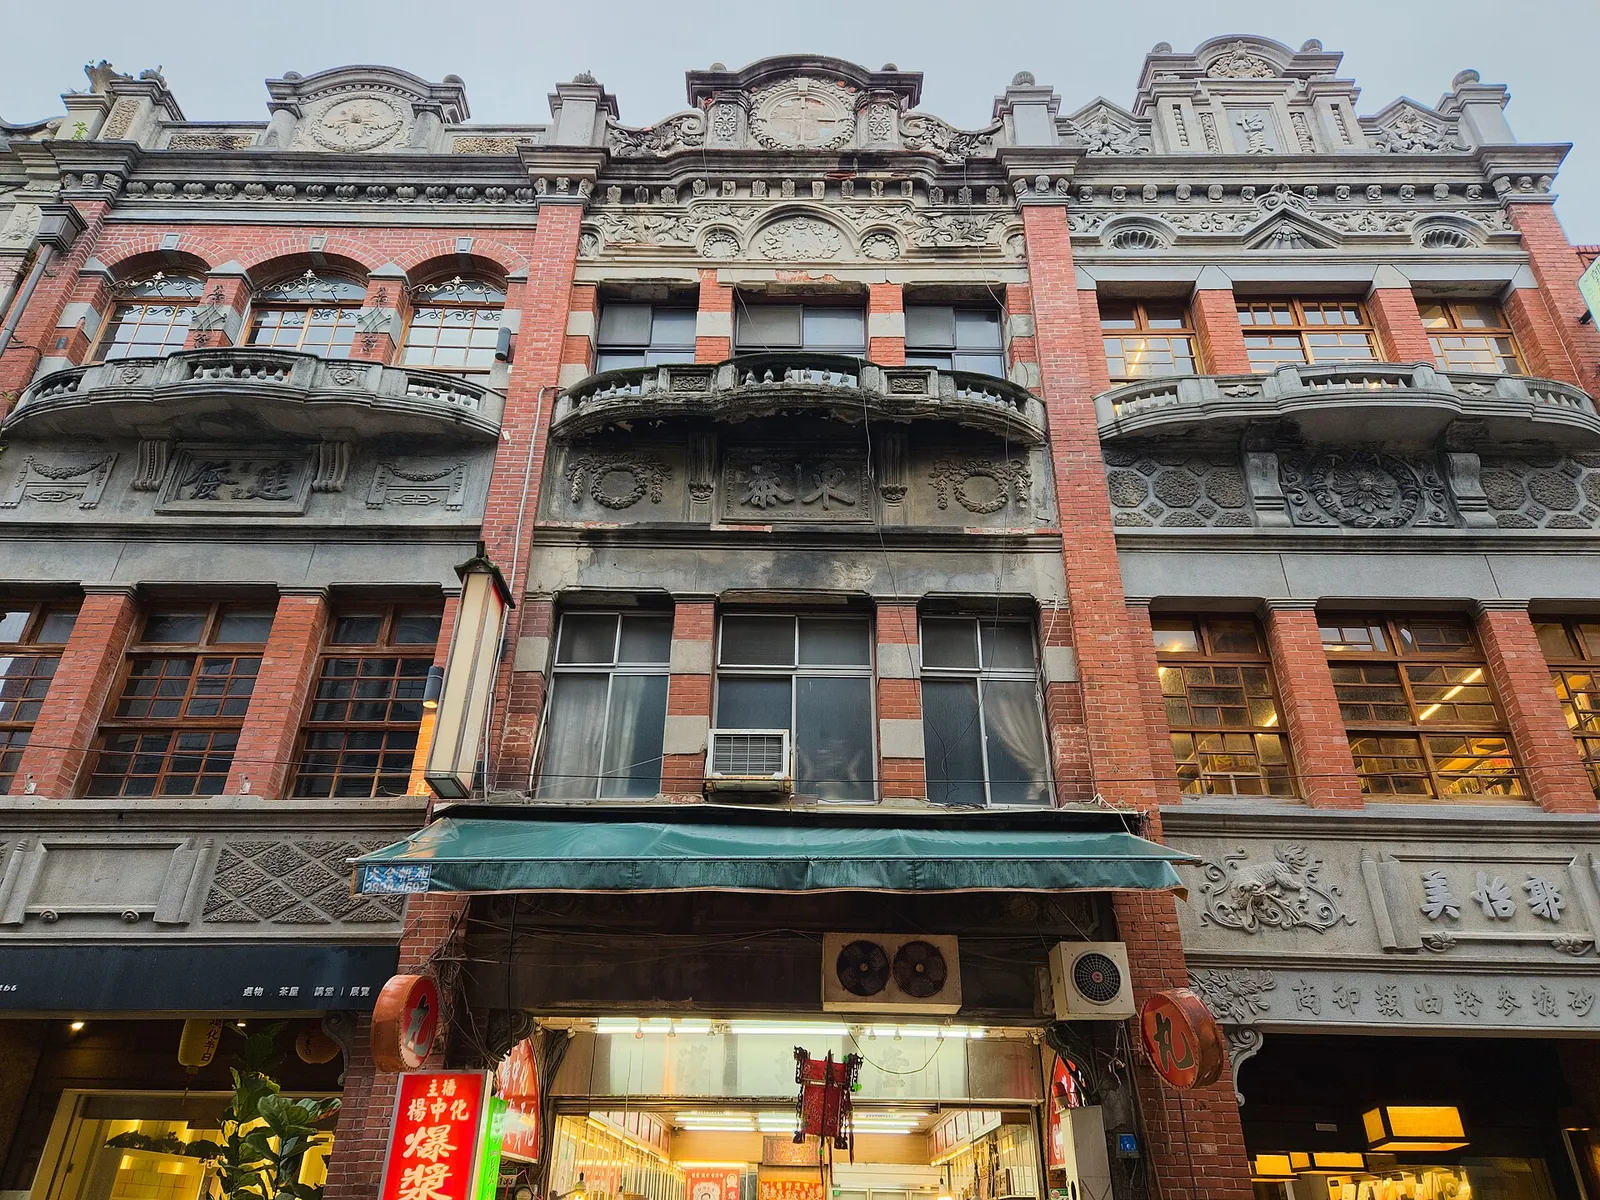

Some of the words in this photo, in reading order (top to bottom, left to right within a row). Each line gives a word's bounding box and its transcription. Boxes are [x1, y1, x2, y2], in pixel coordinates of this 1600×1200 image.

[242, 986, 264, 997] 選物
[278, 986, 300, 997] 茶屋
[313, 986, 335, 997] 講堂
[426, 1079, 457, 1097] 主播
[407, 1098, 469, 1122] 楊中化
[398, 1125, 458, 1200] 爆漿
